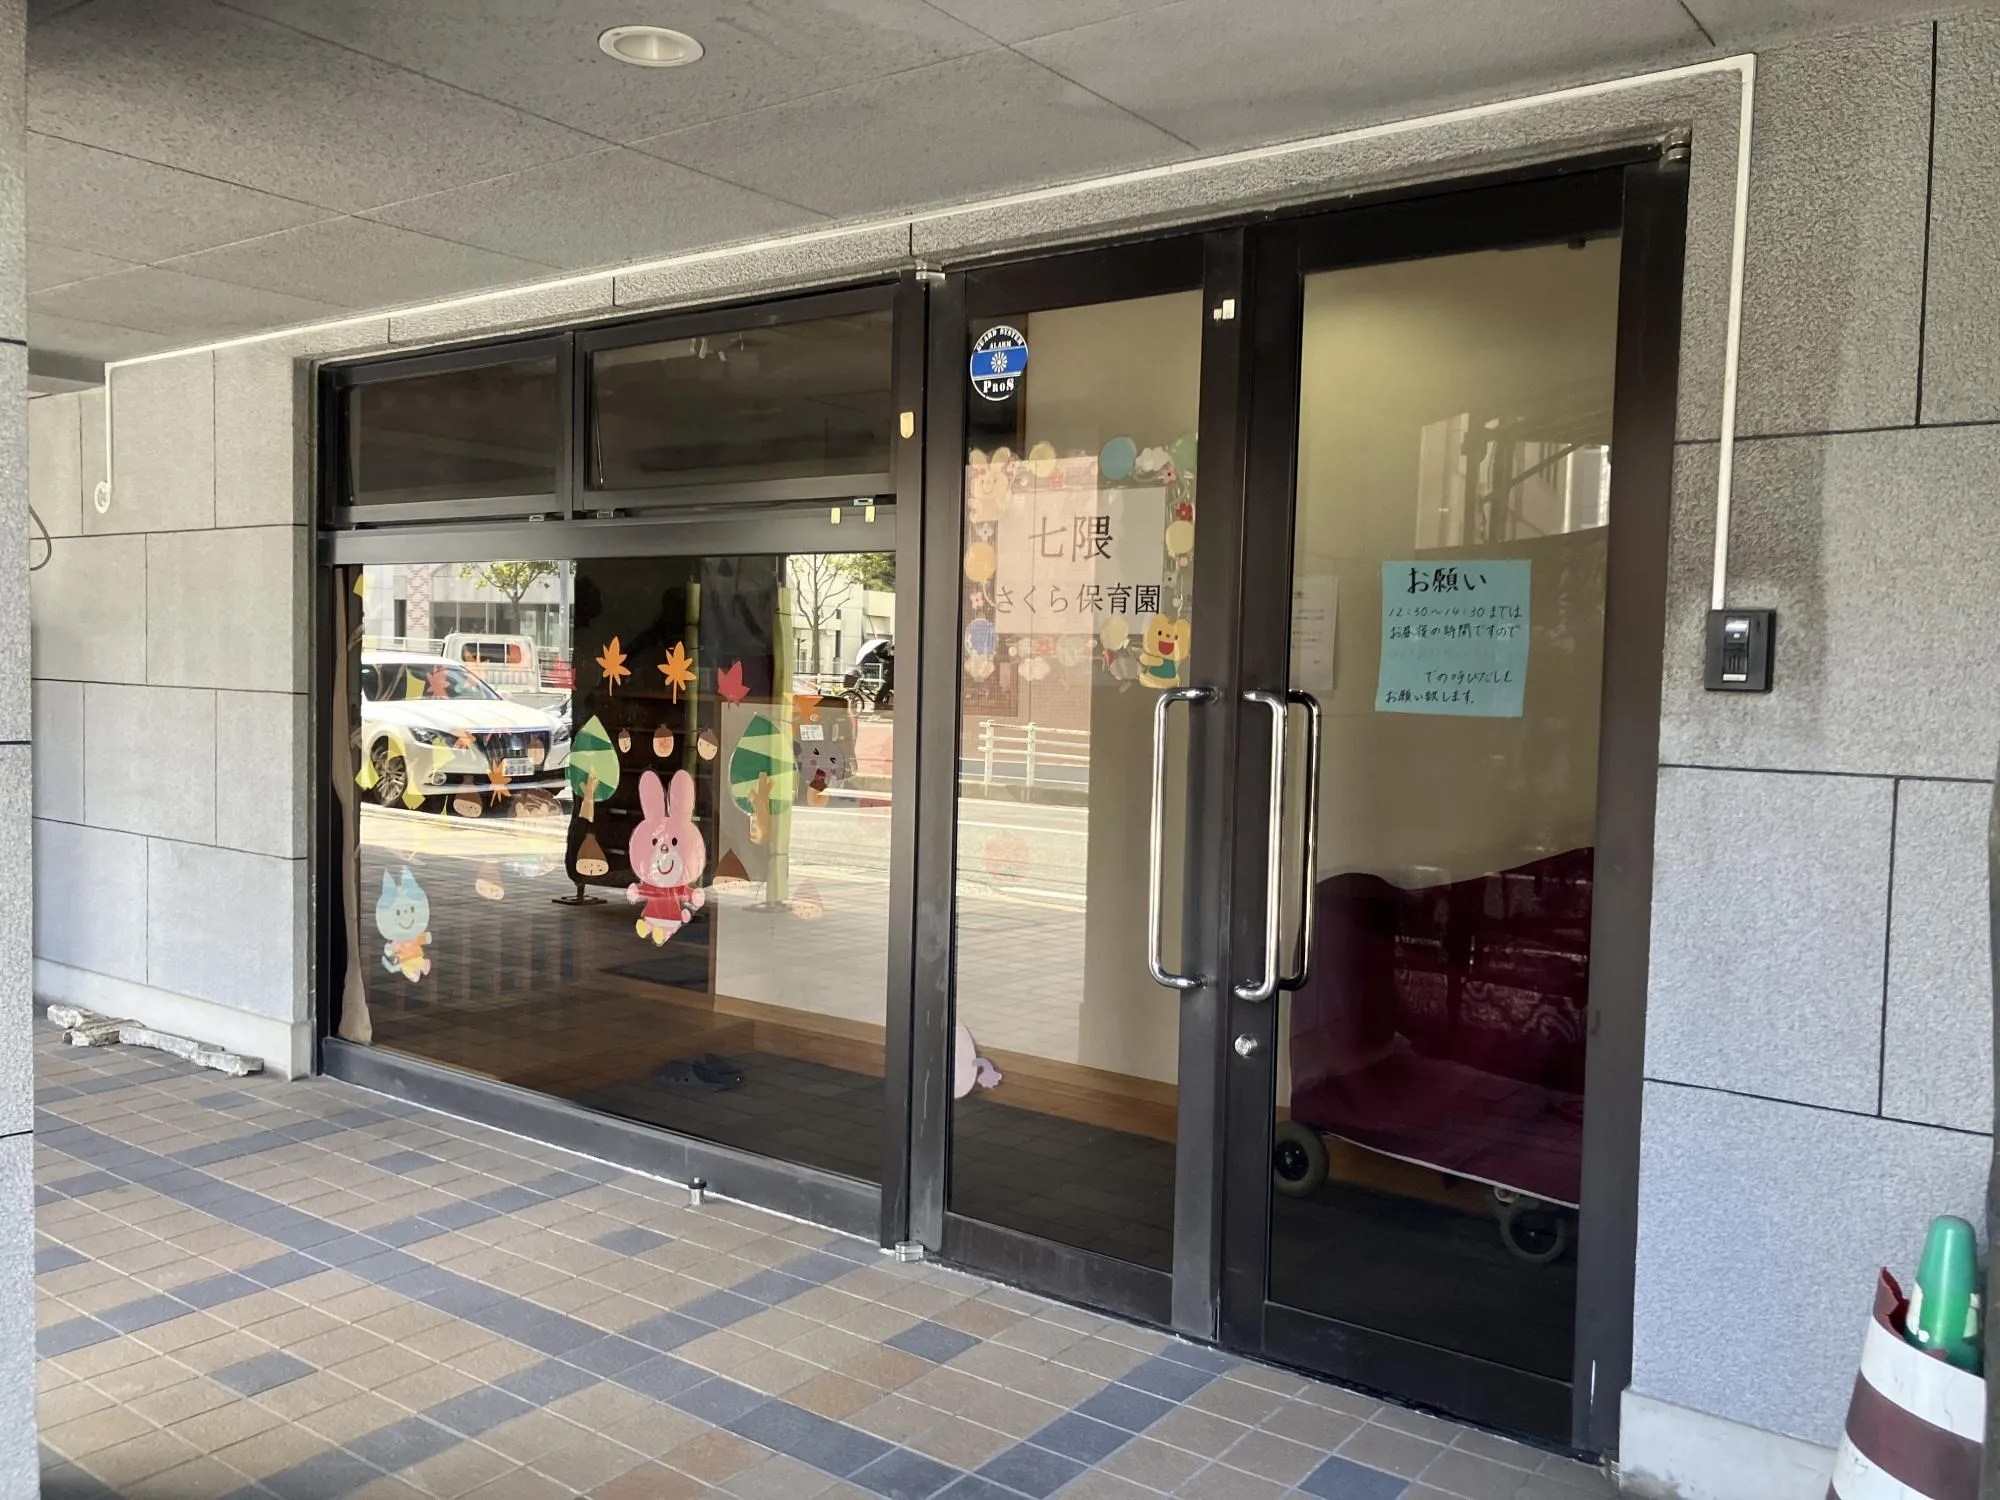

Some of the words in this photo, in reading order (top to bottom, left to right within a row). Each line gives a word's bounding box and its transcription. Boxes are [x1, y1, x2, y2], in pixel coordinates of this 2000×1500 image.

[976, 328, 998, 353] GUARD
[999, 327, 1024, 346] SYSTEM
[989, 340, 1012, 350] ALARM
[1028, 515, 1113, 562] 七隈
[1407, 567, 1488, 594] お願い
[996, 582, 1161, 615] さくら保育園
